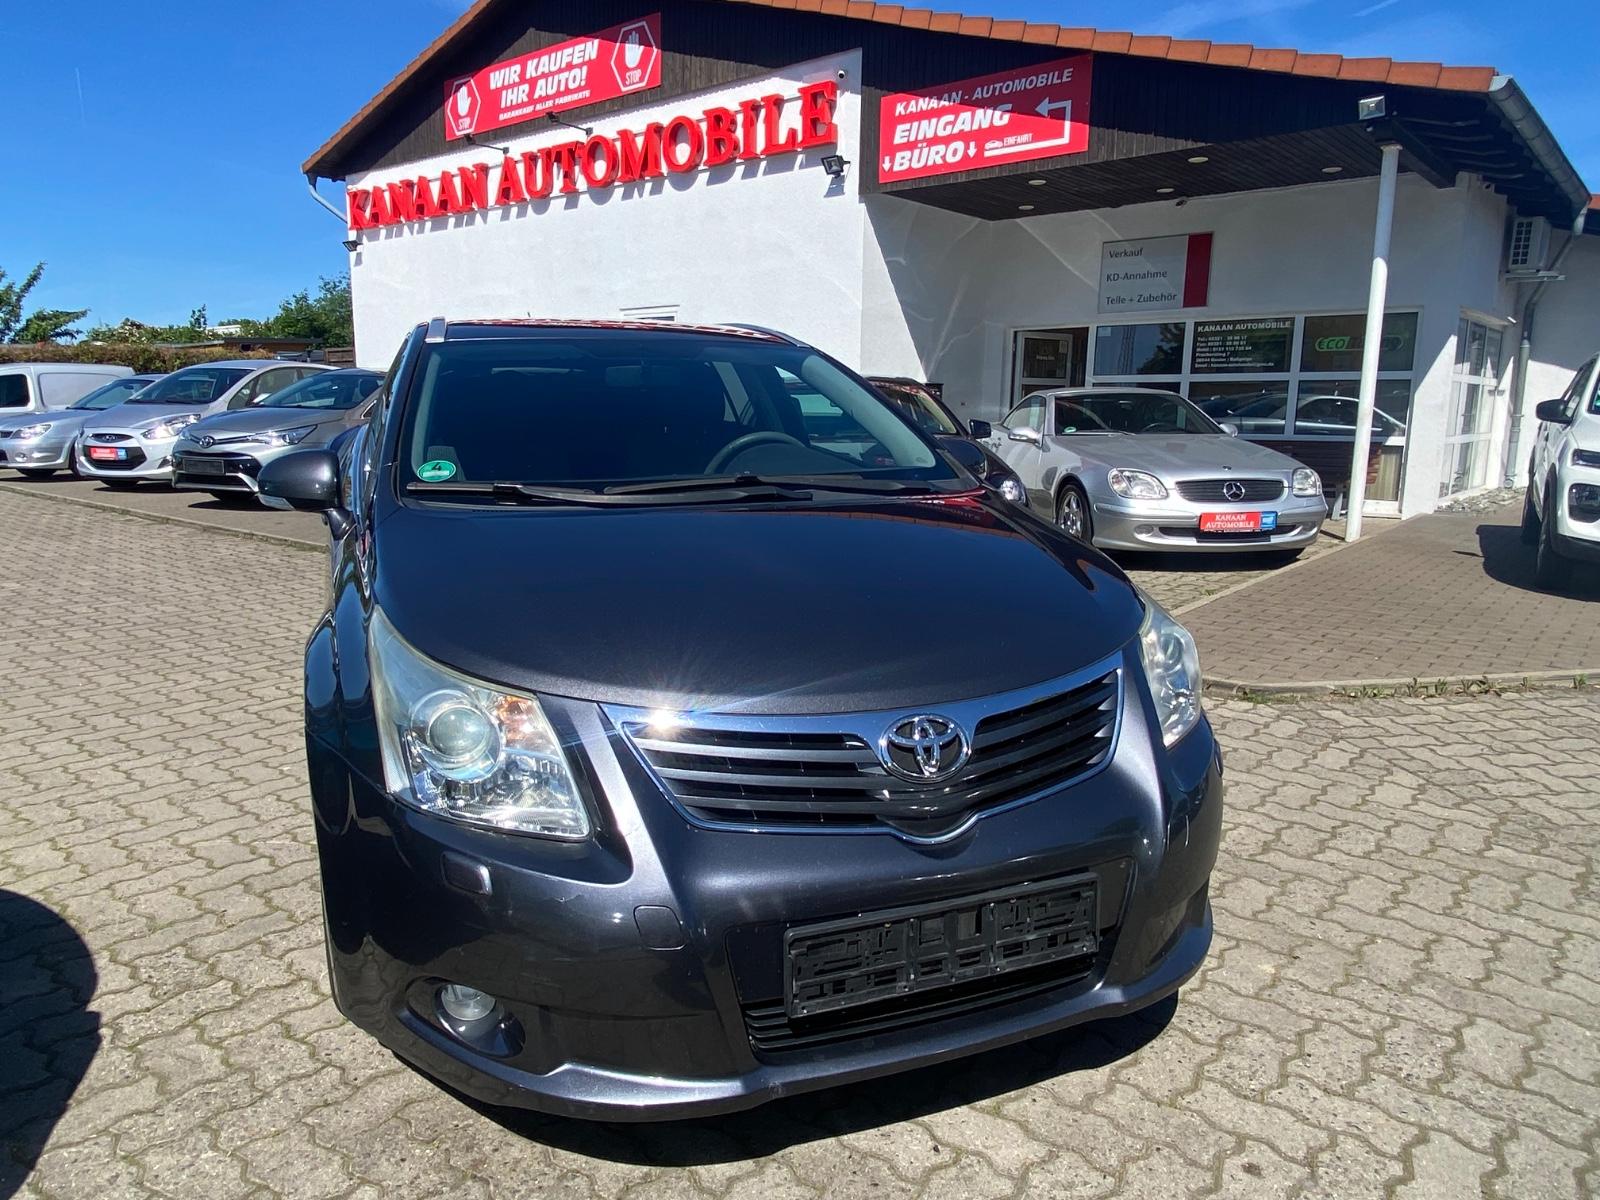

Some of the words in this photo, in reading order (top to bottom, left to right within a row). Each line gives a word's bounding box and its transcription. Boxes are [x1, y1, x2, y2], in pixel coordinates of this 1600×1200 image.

[489, 65, 521, 90] WIR
[525, 39, 599, 78] KAUFEN
[500, 87, 528, 108] IHR
[534, 66, 587, 99] AUTO!
[625, 70, 642, 86] STOP
[535, 99, 554, 111] ALLER
[555, 90, 591, 106] FABRIKATE
[895, 90, 962, 117] KANAAN
[972, 68, 1073, 101] AUTOMOBILE
[458, 117, 471, 131] STOP
[893, 103, 1013, 145] EINGANG
[348, 163, 489, 231] KANAAN
[495, 81, 838, 206] AUTOMOBILE
[893, 141, 965, 172] BÜRO
[1003, 133, 1034, 147] EINFAHRT
[1109, 248, 1143, 259] Verkauf
[1106, 270, 1168, 282] KD-Annahme
[1106, 296, 1126, 305] Teile
[1137, 291, 1177, 303] Zubehör
[1197, 324, 1233, 333] KANAAN
[1235, 321, 1290, 330] AUTOMOBILE
[432, 462, 442, 471] 4
